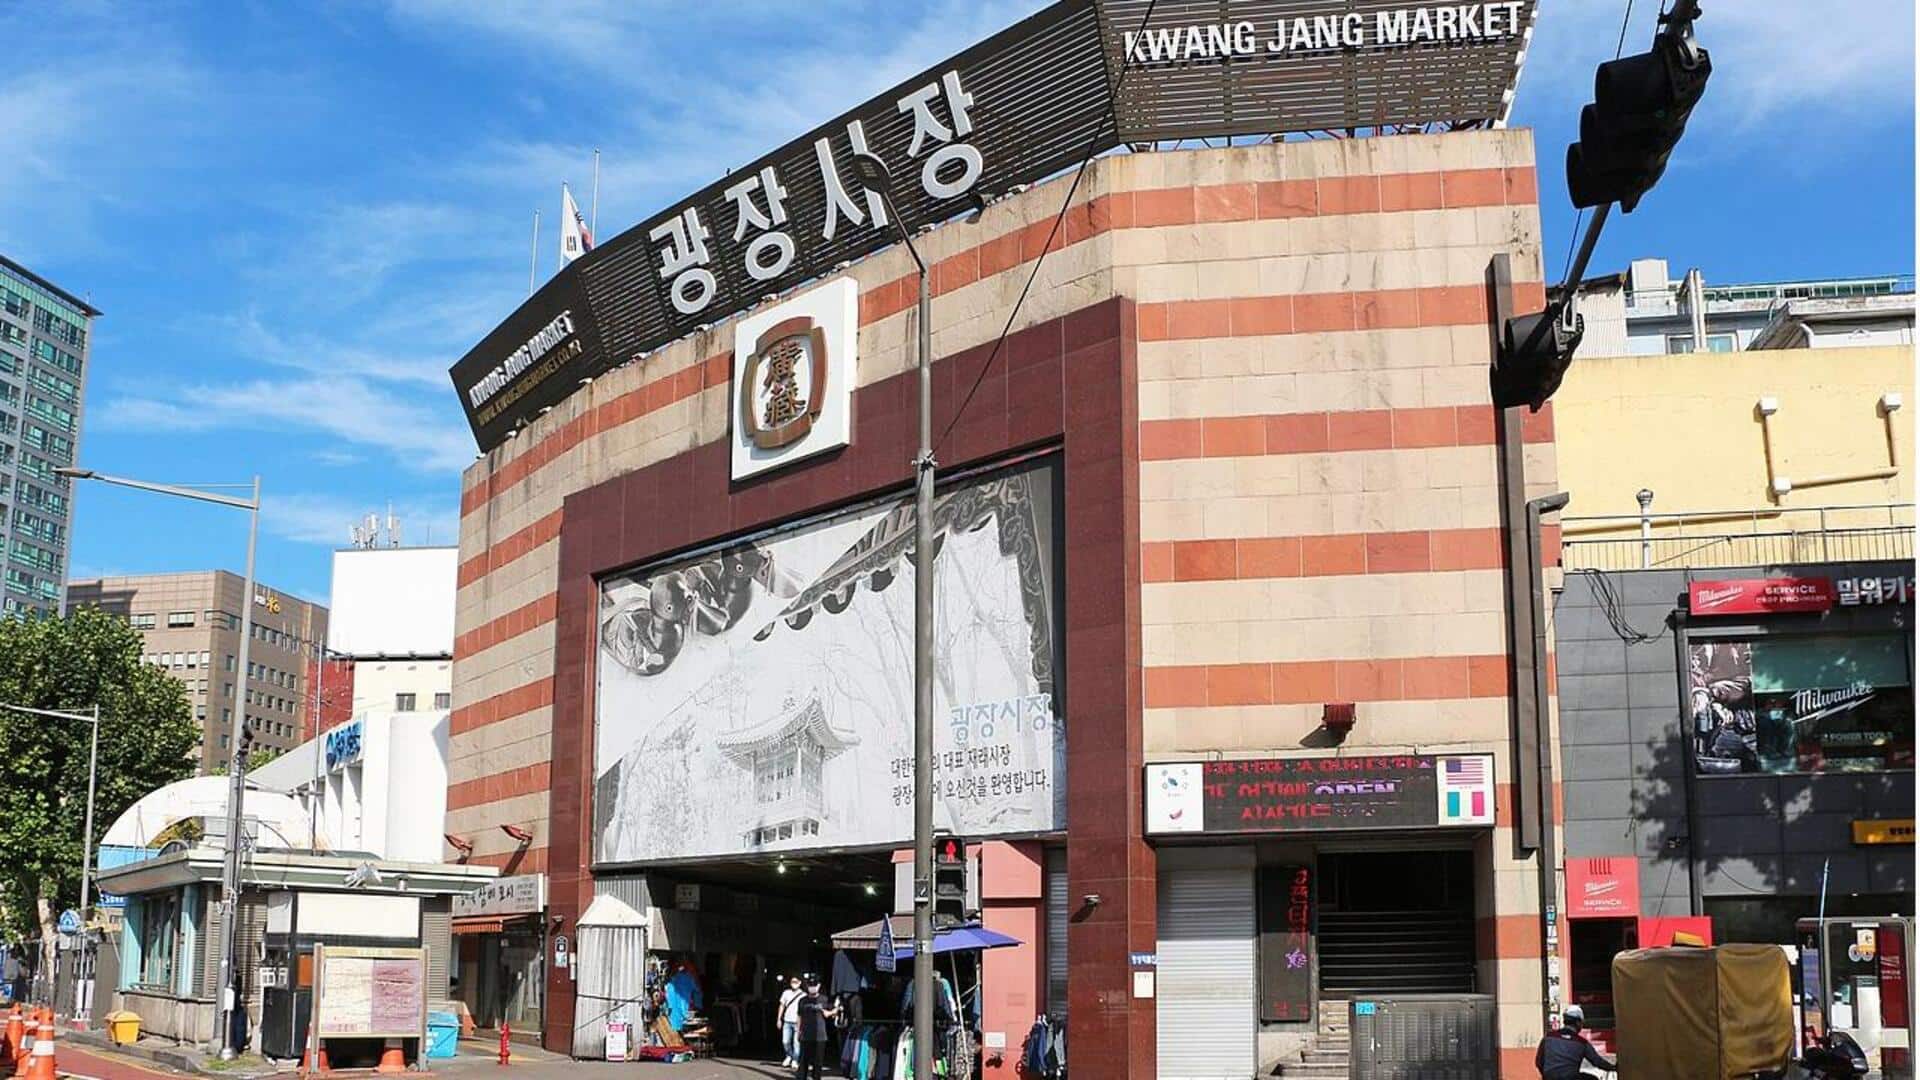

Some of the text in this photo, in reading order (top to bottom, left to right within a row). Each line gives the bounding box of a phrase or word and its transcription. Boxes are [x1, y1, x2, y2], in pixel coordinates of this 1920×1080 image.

[1124, 1, 1525, 63] KWANG JANG MARKET
[649, 70, 984, 315] 광장시장
[1764, 584, 1817, 595] SERVICE
[1837, 575, 1907, 606] 밀워키
[1789, 680, 1875, 716] Milwaukee
[950, 693, 1053, 743] 광장시장
[891, 743, 1011, 779] 대한의 대표 재래시장
[892, 769, 1051, 807] 광장에 오신것을 환영합니다.
